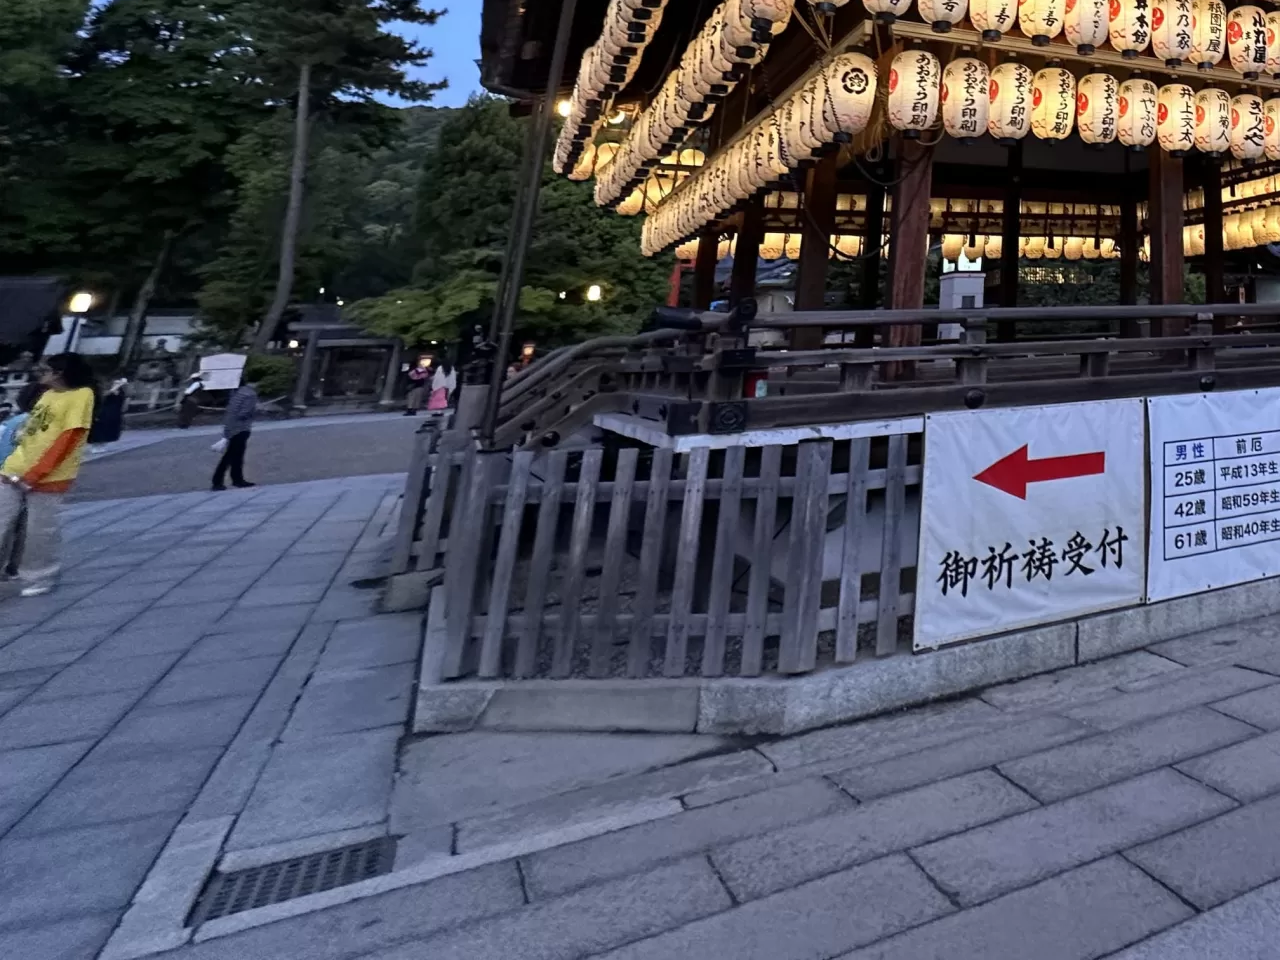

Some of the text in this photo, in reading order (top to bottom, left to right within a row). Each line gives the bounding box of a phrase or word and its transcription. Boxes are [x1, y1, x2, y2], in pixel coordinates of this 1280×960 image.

[908, 54, 930, 127] あおぞら印刷
[959, 62, 978, 132] あおぞら印刷
[1175, 442, 1205, 460] 男性
[1235, 437, 1263, 454] 前厄
[1174, 469, 1206, 487] 25歳
[1220, 460, 1279, 481] 平成13年生
[1174, 499, 1206, 517] 42歳
[1221, 489, 1280, 511] 昭和59年生
[1174, 529, 1208, 550] 61歳
[1221, 518, 1280, 541] 昭和40年生
[936, 526, 1129, 598] 御祈祷受付
